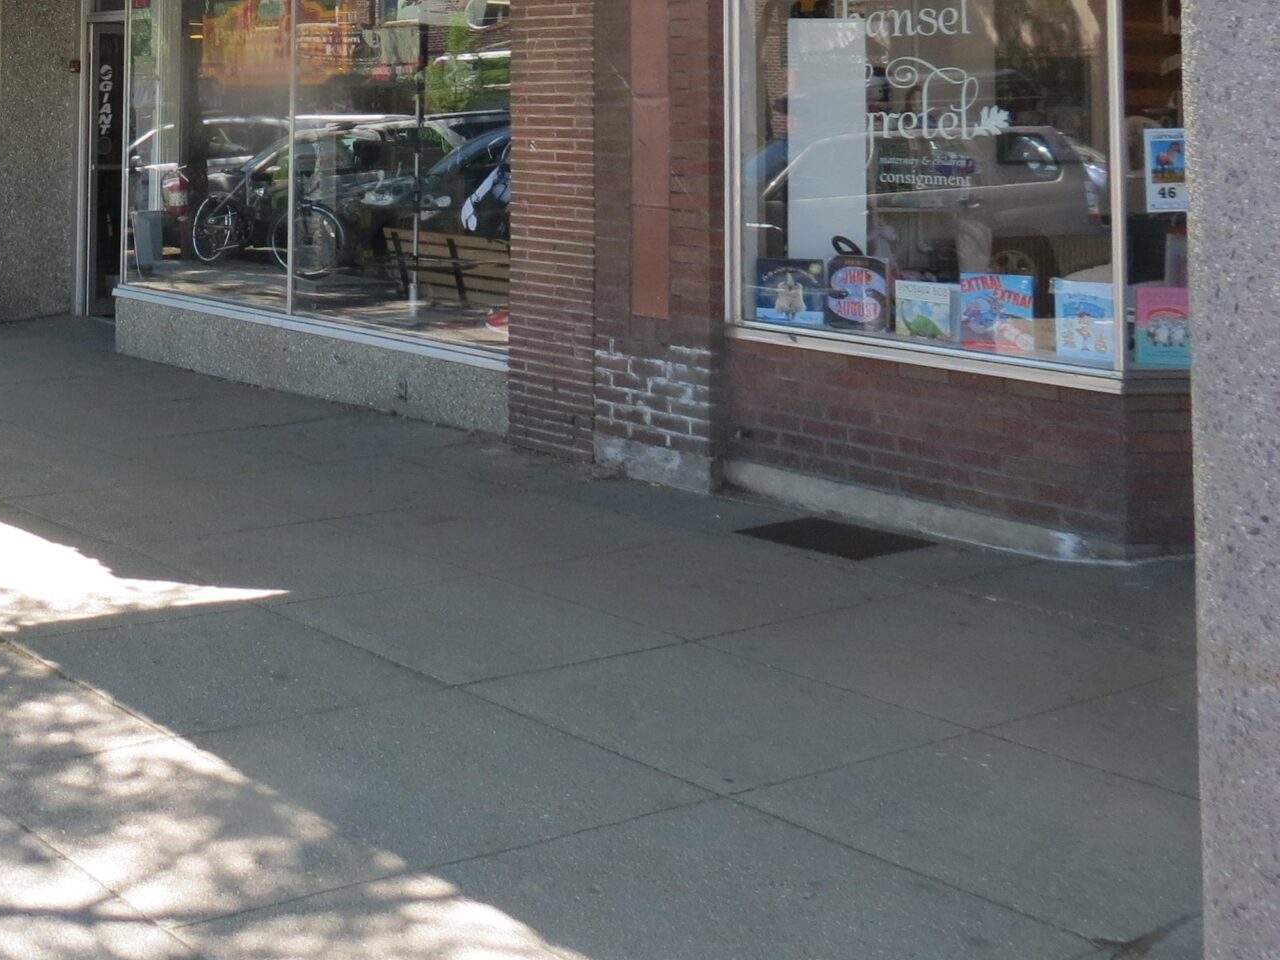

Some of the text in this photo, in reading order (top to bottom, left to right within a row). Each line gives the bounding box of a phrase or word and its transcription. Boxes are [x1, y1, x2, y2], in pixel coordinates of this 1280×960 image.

[97, 80, 113, 135] GIANT
[879, 169, 973, 189] consignment
[1157, 186, 1177, 199] 46
[960, 275, 1002, 293] EXTRA!
[992, 289, 1033, 309] EXTRA!
